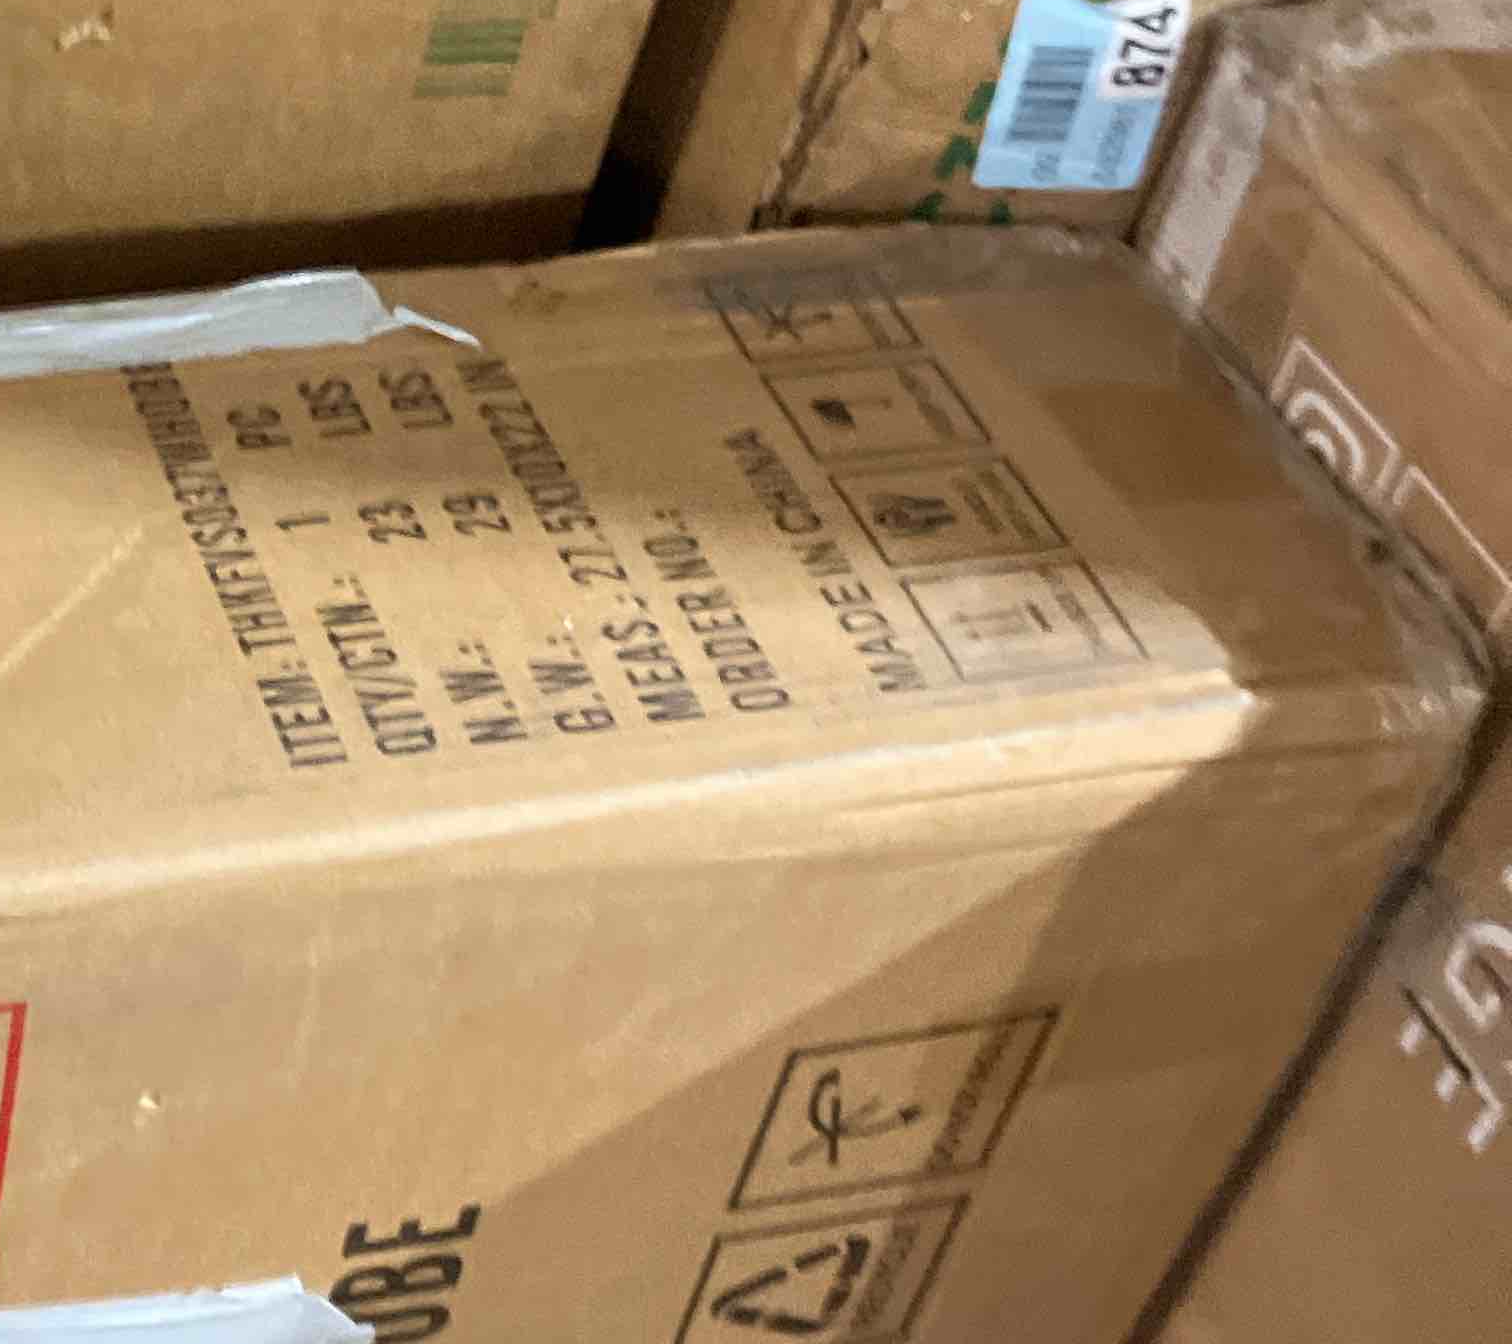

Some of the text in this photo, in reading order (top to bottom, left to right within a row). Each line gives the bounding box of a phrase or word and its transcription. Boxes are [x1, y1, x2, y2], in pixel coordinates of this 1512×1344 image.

[1111, 2, 1179, 88] 874
[227, 402, 292, 450] PC
[298, 375, 372, 439] LBS
[378, 369, 454, 430] LBS
[274, 511, 331, 531] 1
[357, 499, 427, 544] 23
[442, 493, 512, 535] 29
[723, 427, 928, 693] MADE IN CHINA
[674, 587, 792, 712] ORDER
